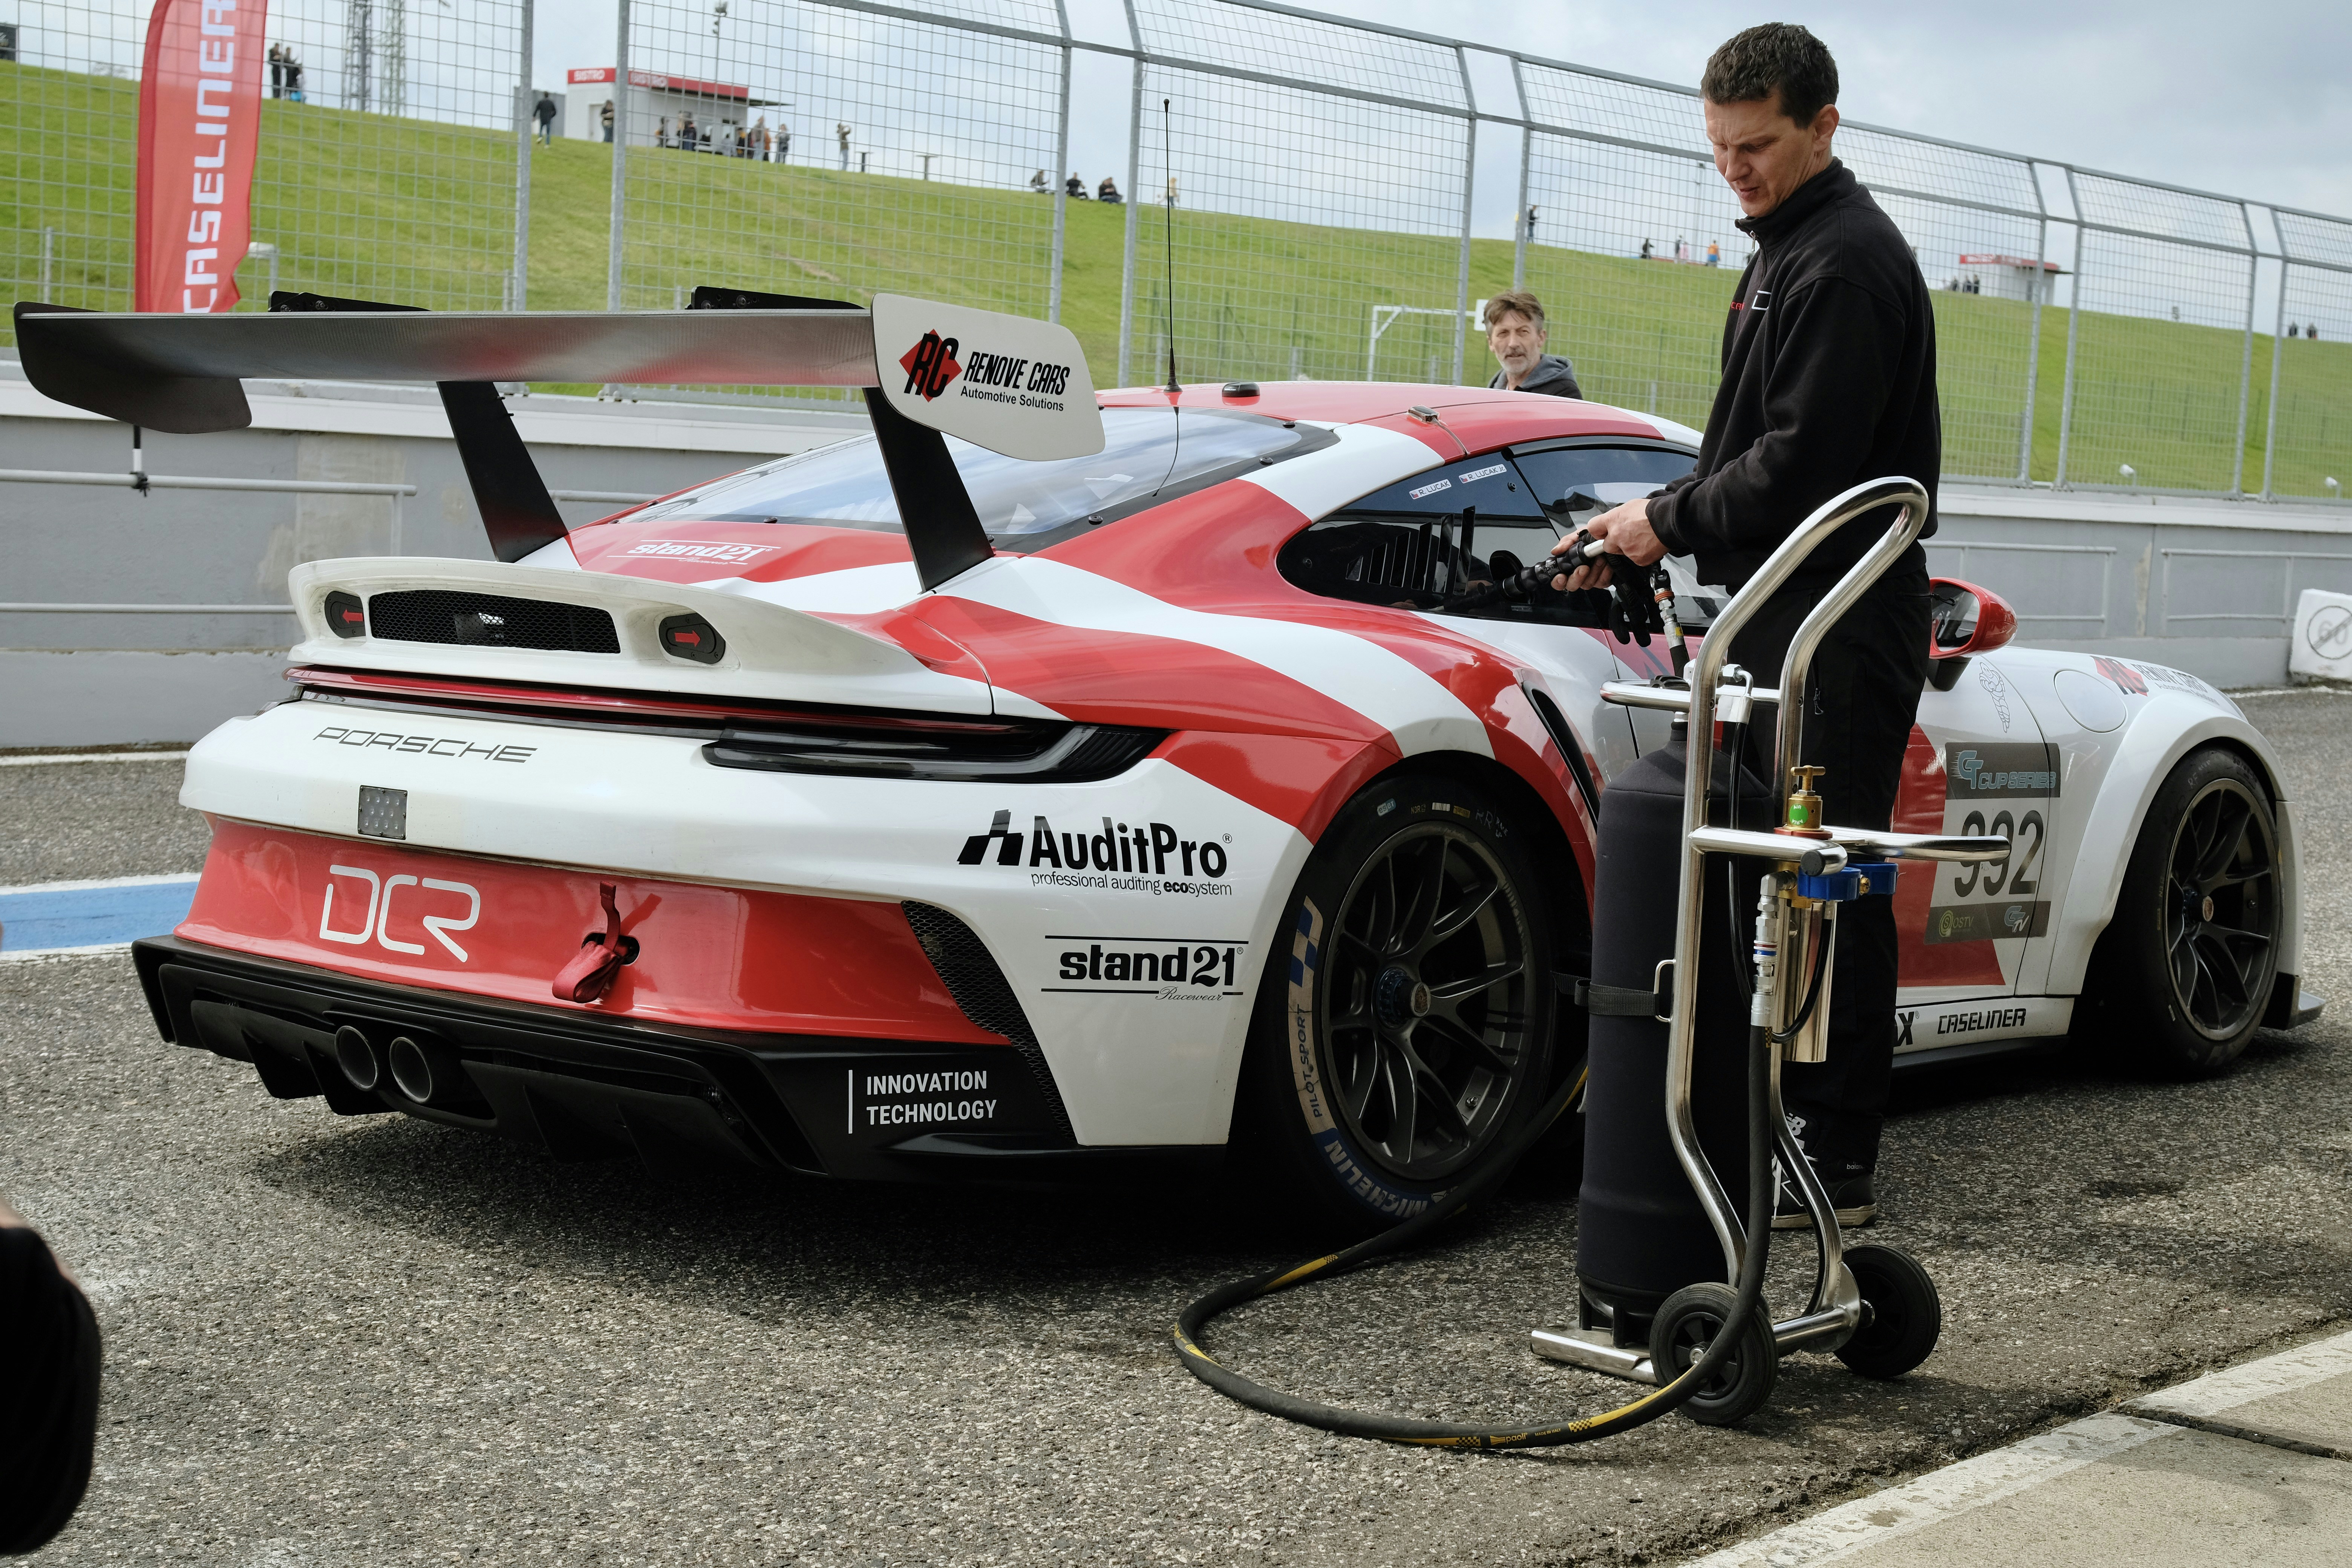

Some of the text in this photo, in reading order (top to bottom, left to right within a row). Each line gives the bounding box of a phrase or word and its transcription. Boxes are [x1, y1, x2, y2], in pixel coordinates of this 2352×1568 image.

[904, 333, 959, 398] RC
[964, 351, 1070, 395] RENOVE CARS
[961, 386, 1064, 411] Automotive Solutions
[1427, 481, 1450, 493] LUCAK
[1476, 467, 1499, 478] LUCAK
[312, 727, 538, 763] PORSCHE
[1958, 750, 1984, 789] GT
[1954, 810, 2043, 897] 992
[1031, 871, 1232, 897] professional auditing ecosystem
[319, 864, 481, 963] DCR
[1155, 986, 1225, 1001] Racewear
[1937, 1008, 2026, 1034] CASELINER
[1297, 1004, 1323, 1118] PILOT SPORT
[867, 1070, 987, 1095] INNOVATION
[866, 1099, 997, 1125] TECHNOLOGY
[1324, 1140, 1428, 1218] MICHELIN
